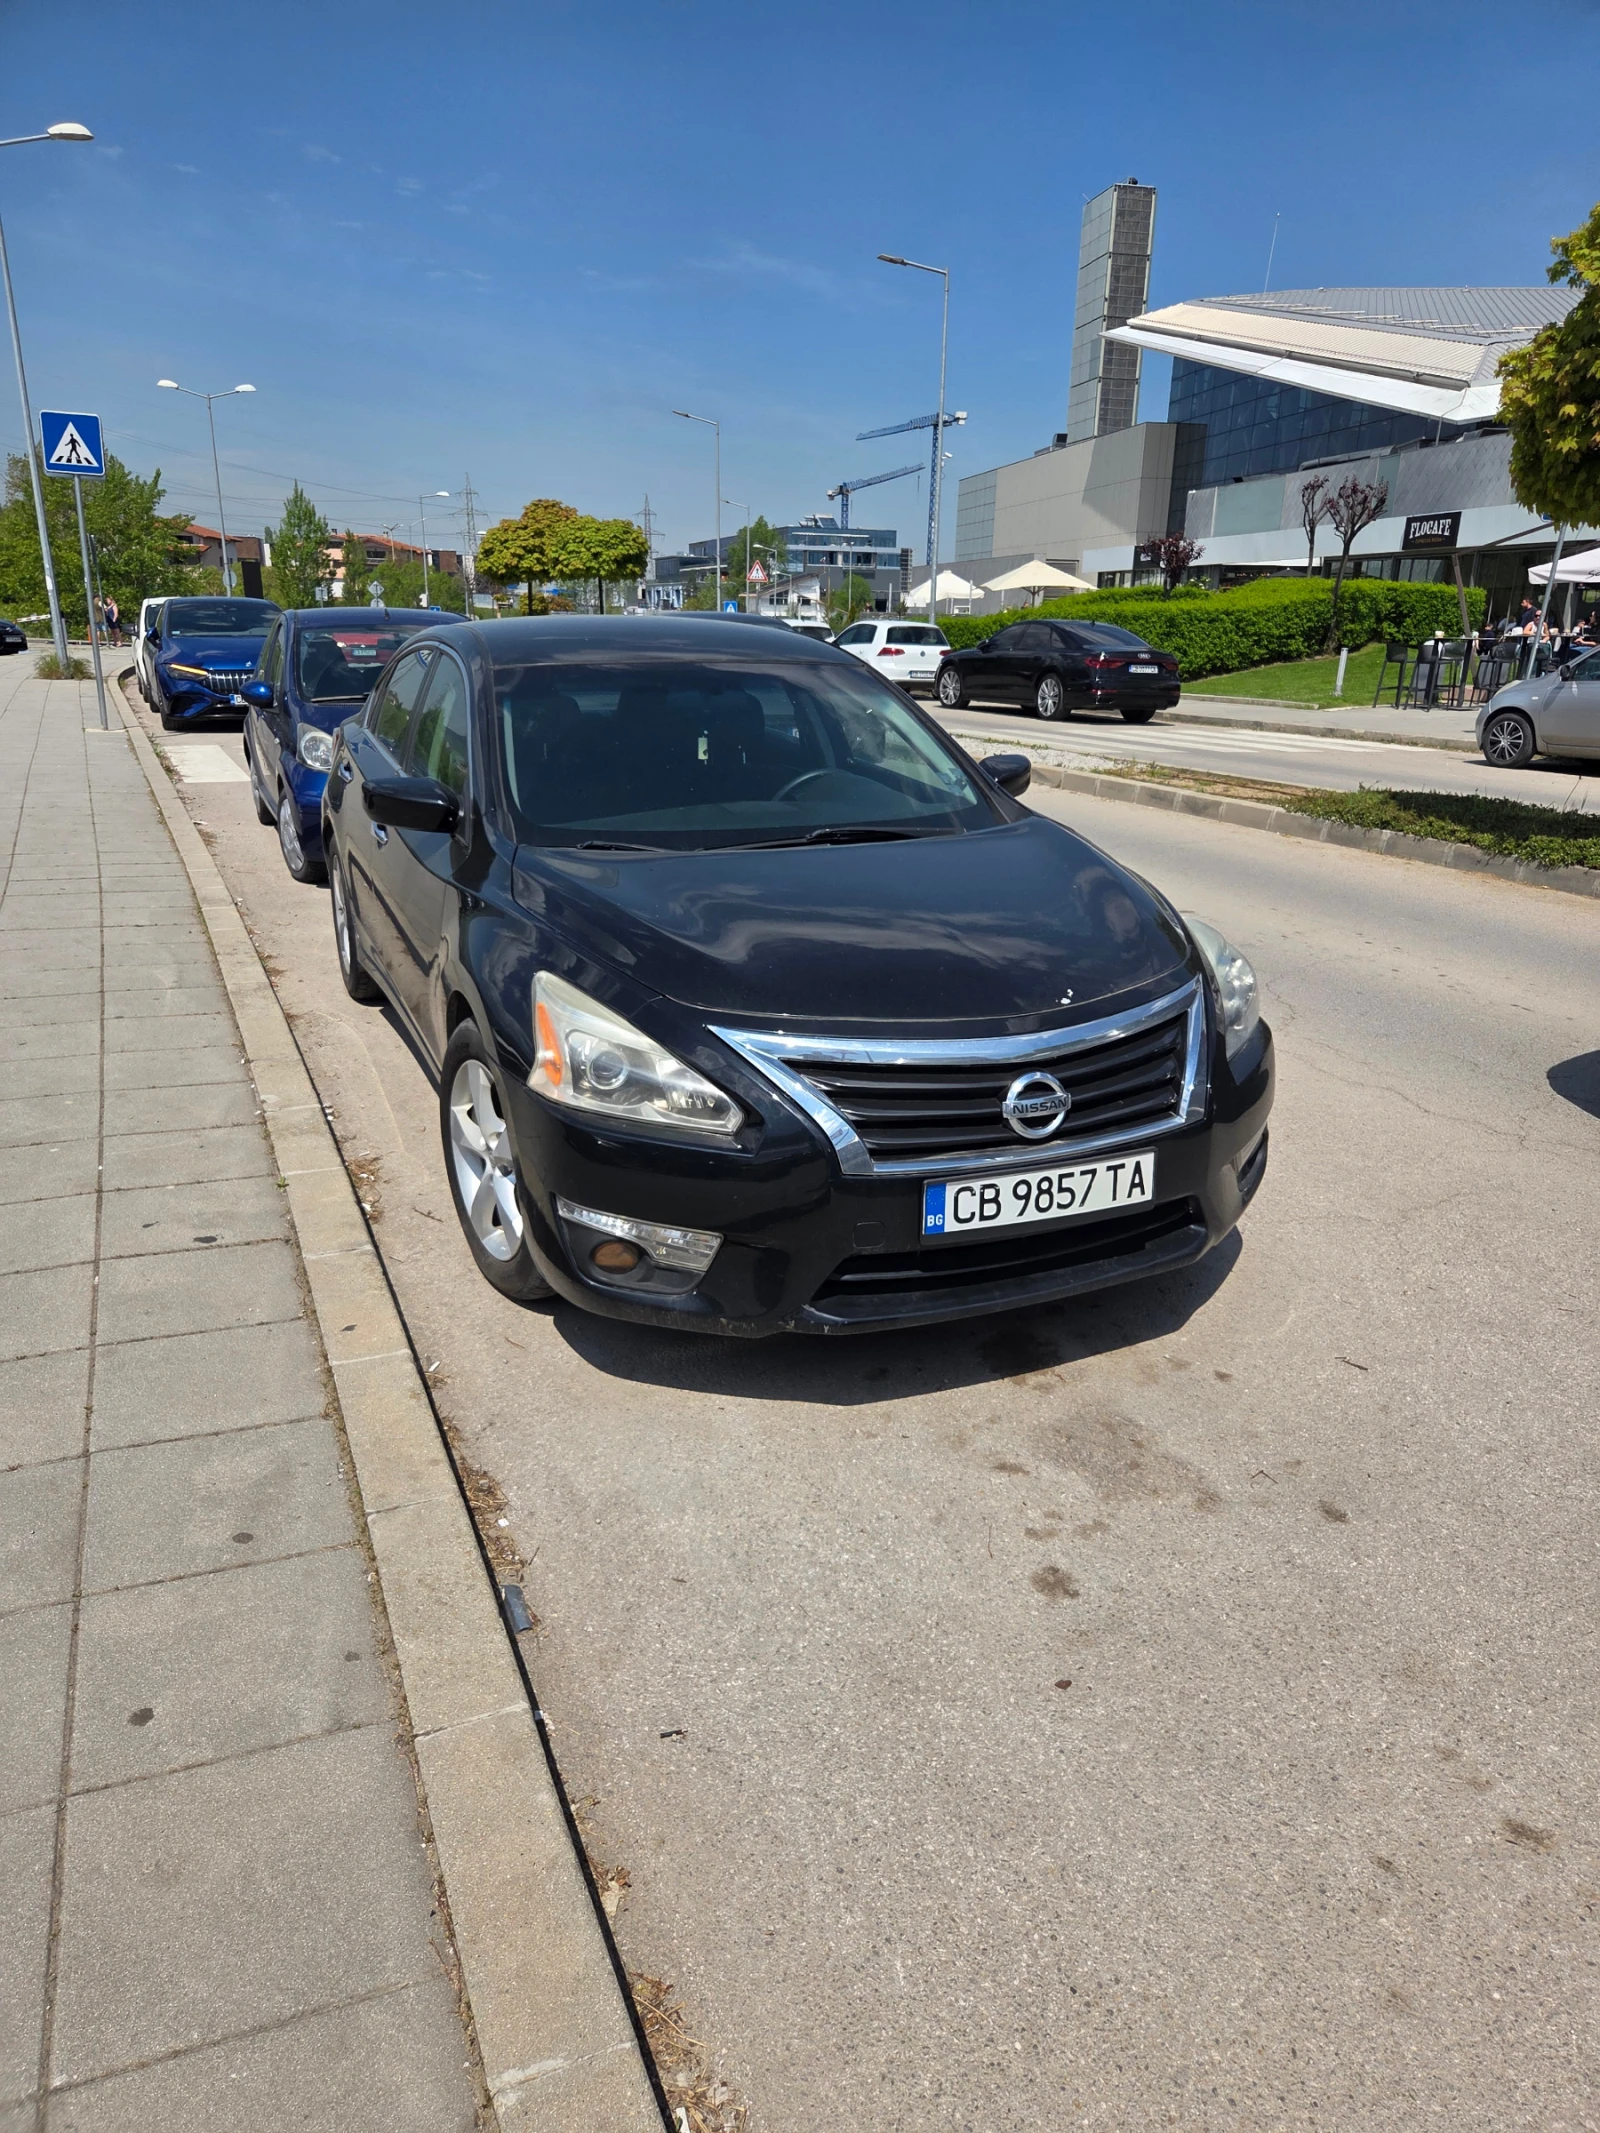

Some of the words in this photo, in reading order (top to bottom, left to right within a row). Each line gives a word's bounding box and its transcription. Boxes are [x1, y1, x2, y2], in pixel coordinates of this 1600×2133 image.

[1409, 518, 1452, 539] FLOCAFE
[1013, 1098, 1067, 1115] NISSAN
[953, 1183, 1002, 1224] CB
[1012, 1168, 1098, 1217] 9857
[1106, 1161, 1146, 1201] TA
[927, 1214, 944, 1227] BG
